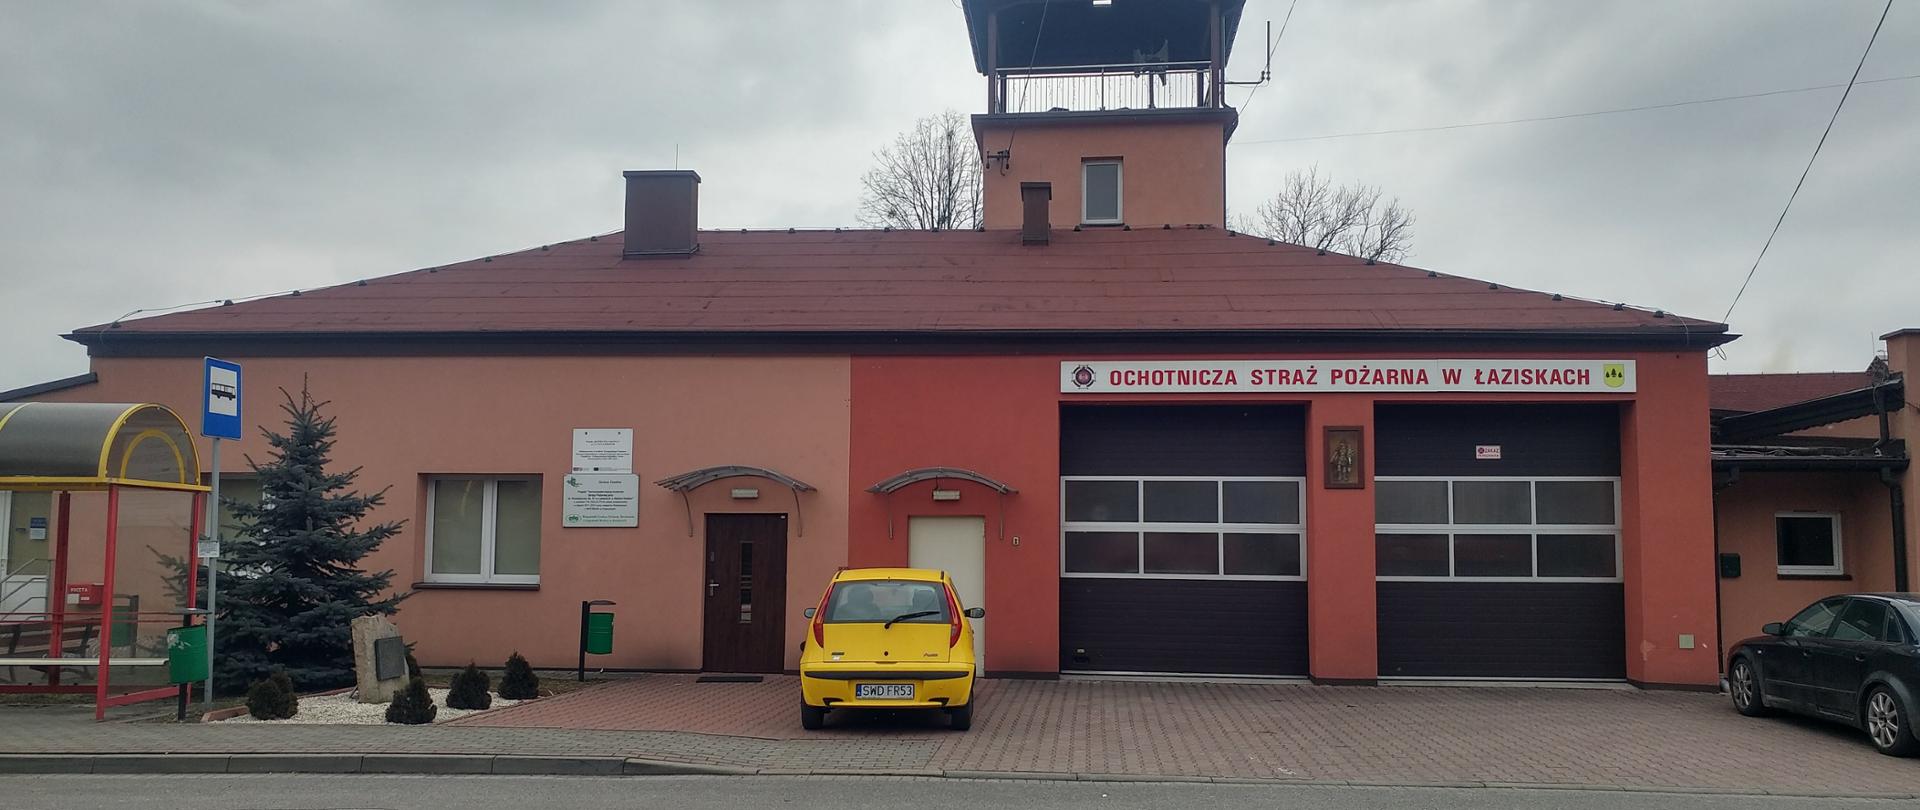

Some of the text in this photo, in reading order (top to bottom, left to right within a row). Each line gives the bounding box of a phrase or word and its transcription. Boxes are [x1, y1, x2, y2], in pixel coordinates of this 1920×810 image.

[1110, 364, 1590, 386] OCHOTNICZA STRAŻ POŻARNA W ŁAZISKACH
[863, 686, 912, 696] SWD FR53
